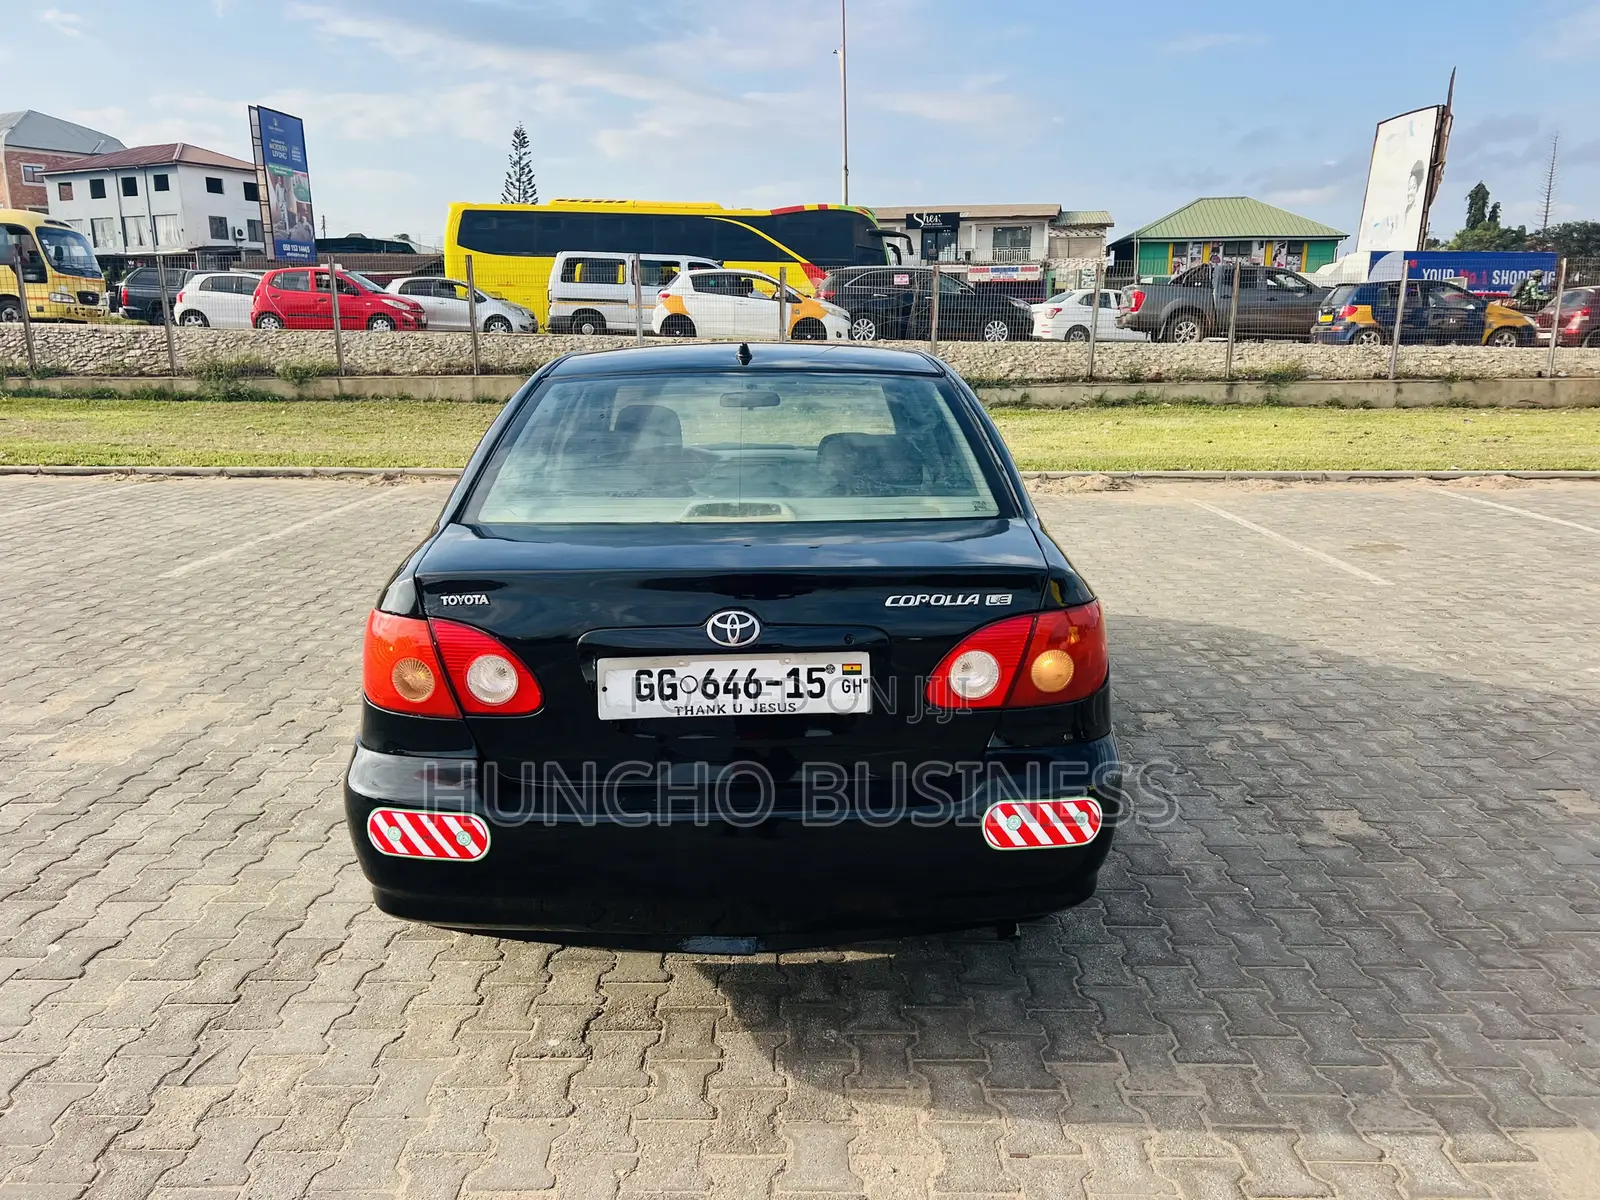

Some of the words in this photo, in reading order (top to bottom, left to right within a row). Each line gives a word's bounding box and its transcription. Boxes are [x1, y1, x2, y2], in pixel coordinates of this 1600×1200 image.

[440, 594, 490, 606] TOYOTA
[885, 594, 981, 607] COROLLA
[986, 594, 1013, 606] LE
[635, 668, 679, 702] GG
[701, 666, 827, 700] 646-15
[841, 678, 863, 694] GH
[674, 704, 727, 716] THANK
[732, 703, 744, 714] U
[749, 702, 797, 713] JESUS
